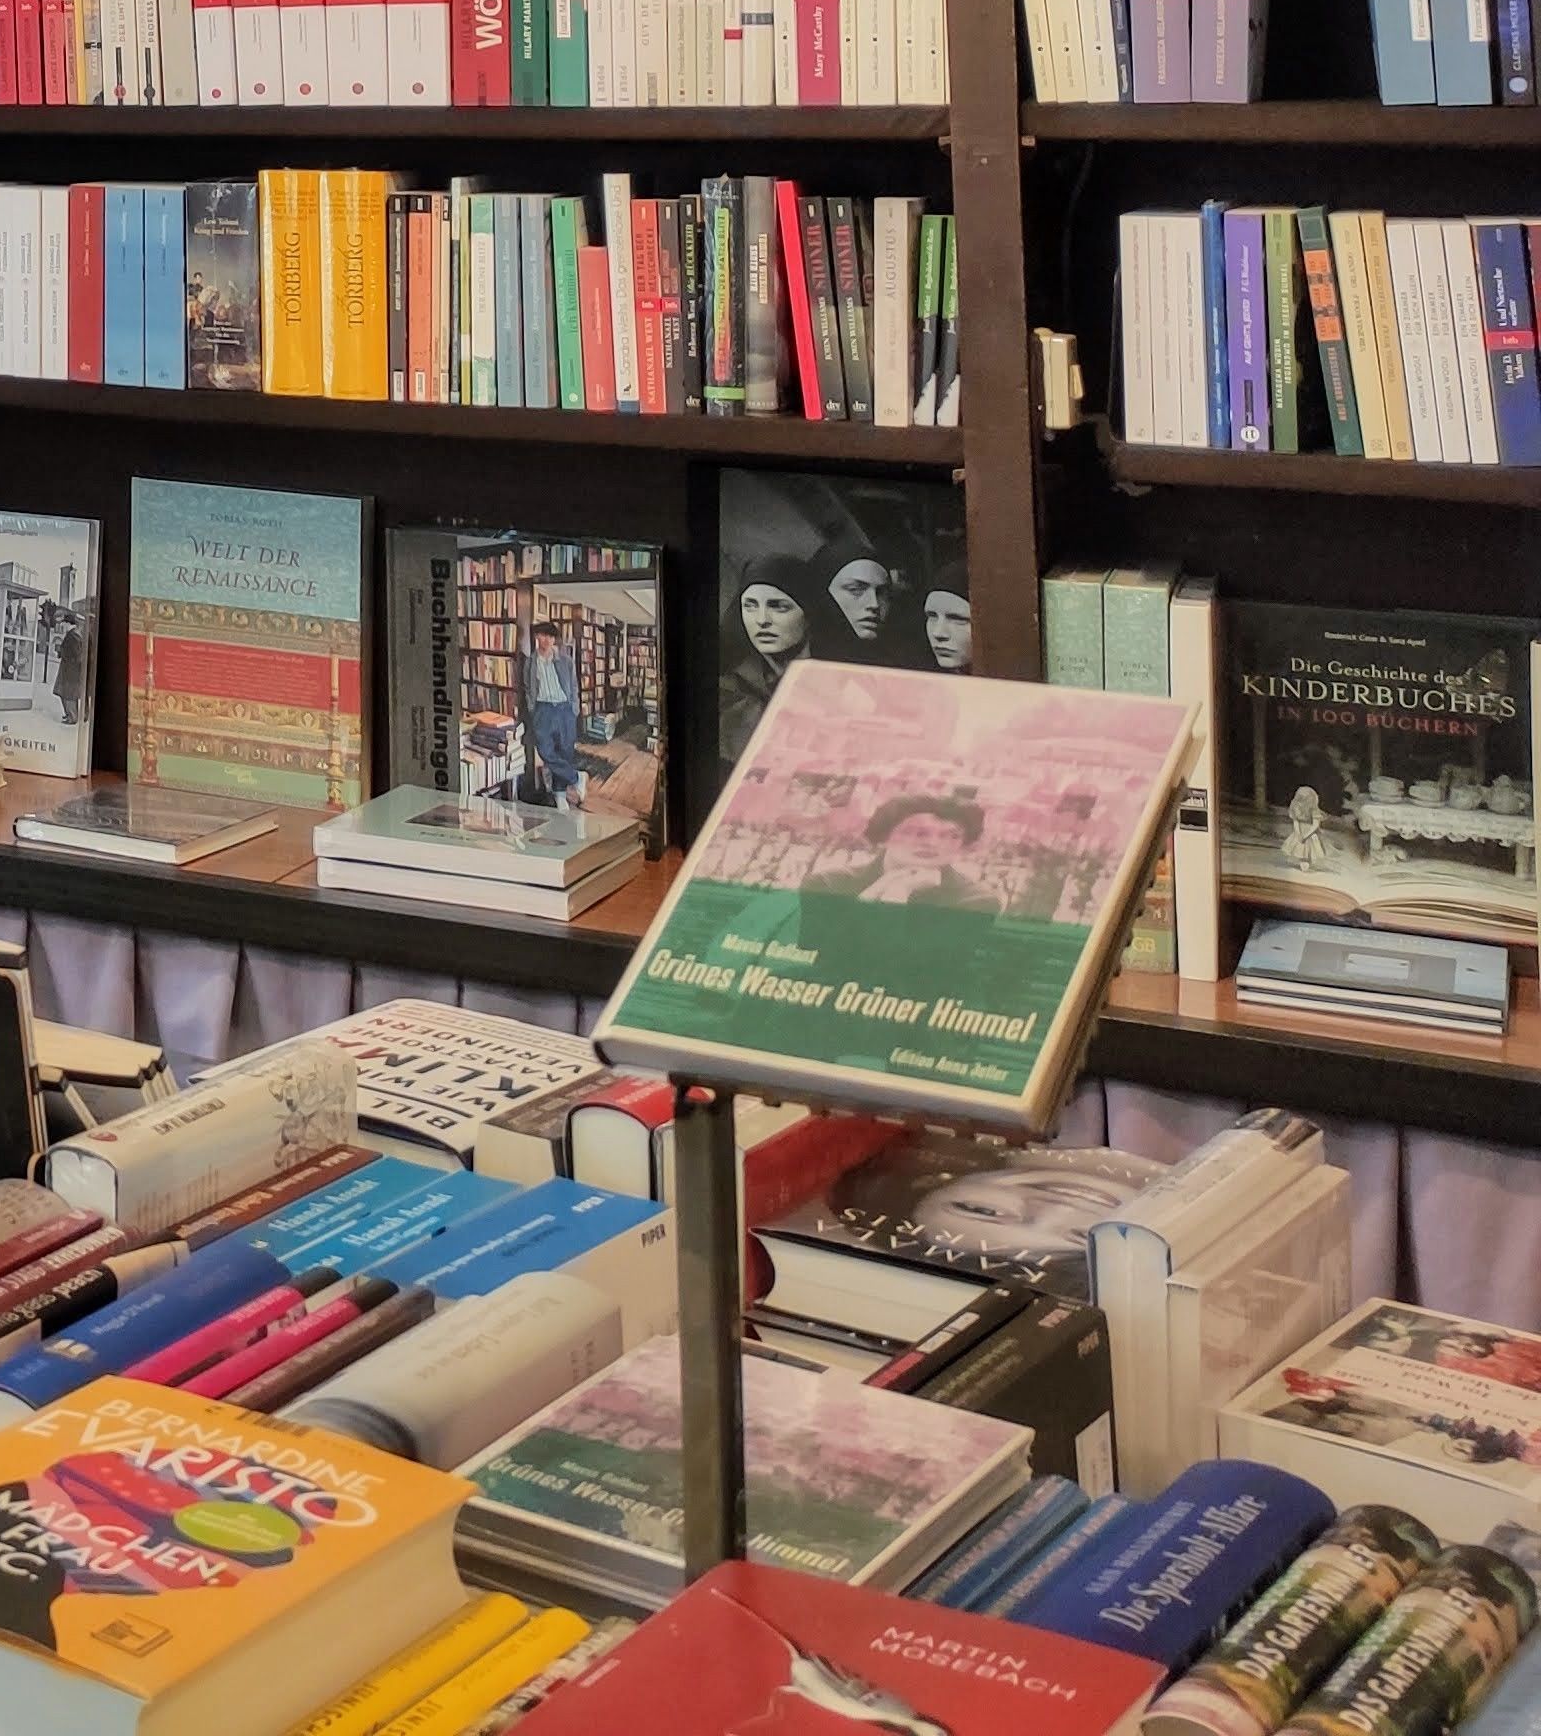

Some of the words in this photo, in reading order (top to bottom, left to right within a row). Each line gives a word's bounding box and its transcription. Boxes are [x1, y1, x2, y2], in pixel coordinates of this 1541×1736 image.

[523, 23, 534, 60] HILARY
[813, 5, 823, 51] McCarthy
[813, 51, 824, 80] Mary
[283, 229, 302, 328] TORBERG
[346, 231, 366, 330] TORBERG
[885, 224, 896, 301] AUGUSTUS
[644, 316, 654, 345] WEST
[645, 347, 657, 406] NATHANAEL
[188, 534, 254, 566] WELT
[258, 541, 302, 570] DER
[171, 563, 320, 599] RENAISSANCE
[1291, 657, 1320, 674] Die
[1326, 658, 1429, 681] Geschichte
[1433, 664, 1465, 685] des
[1241, 673, 1517, 720] KINDERBUCHES
[1363, 710, 1480, 737] BÜCHERN
[647, 948, 736, 994] Grünes
[737, 965, 834, 1010] Wasser
[834, 981, 928, 1025] Grüner
[928, 996, 1038, 1044] Himmel
[341, 1025, 563, 1082] KATASTROPHE
[365, 1016, 585, 1075] VERHINDERN
[322, 1032, 545, 1104] KLIMA
[369, 1095, 459, 1132] BILL
[437, 1083, 497, 1112] WIE
[640, 1222, 668, 1249] PIPER
[21, 1406, 378, 1529] EVARISTO
[94, 1399, 386, 1496] BERNARDINE
[571, 1480, 658, 1515] Wasser
[5, 1514, 134, 1577] FRAU
[747, 1532, 852, 1574] Himmel
[1099, 1602, 1147, 1633] Die
[868, 1637, 1078, 1701] MOSEBACH
[883, 1625, 1028, 1671] MARTIN
[1235, 1649, 1268, 1682] DAS
[1337, 1696, 1373, 1731] DAS
